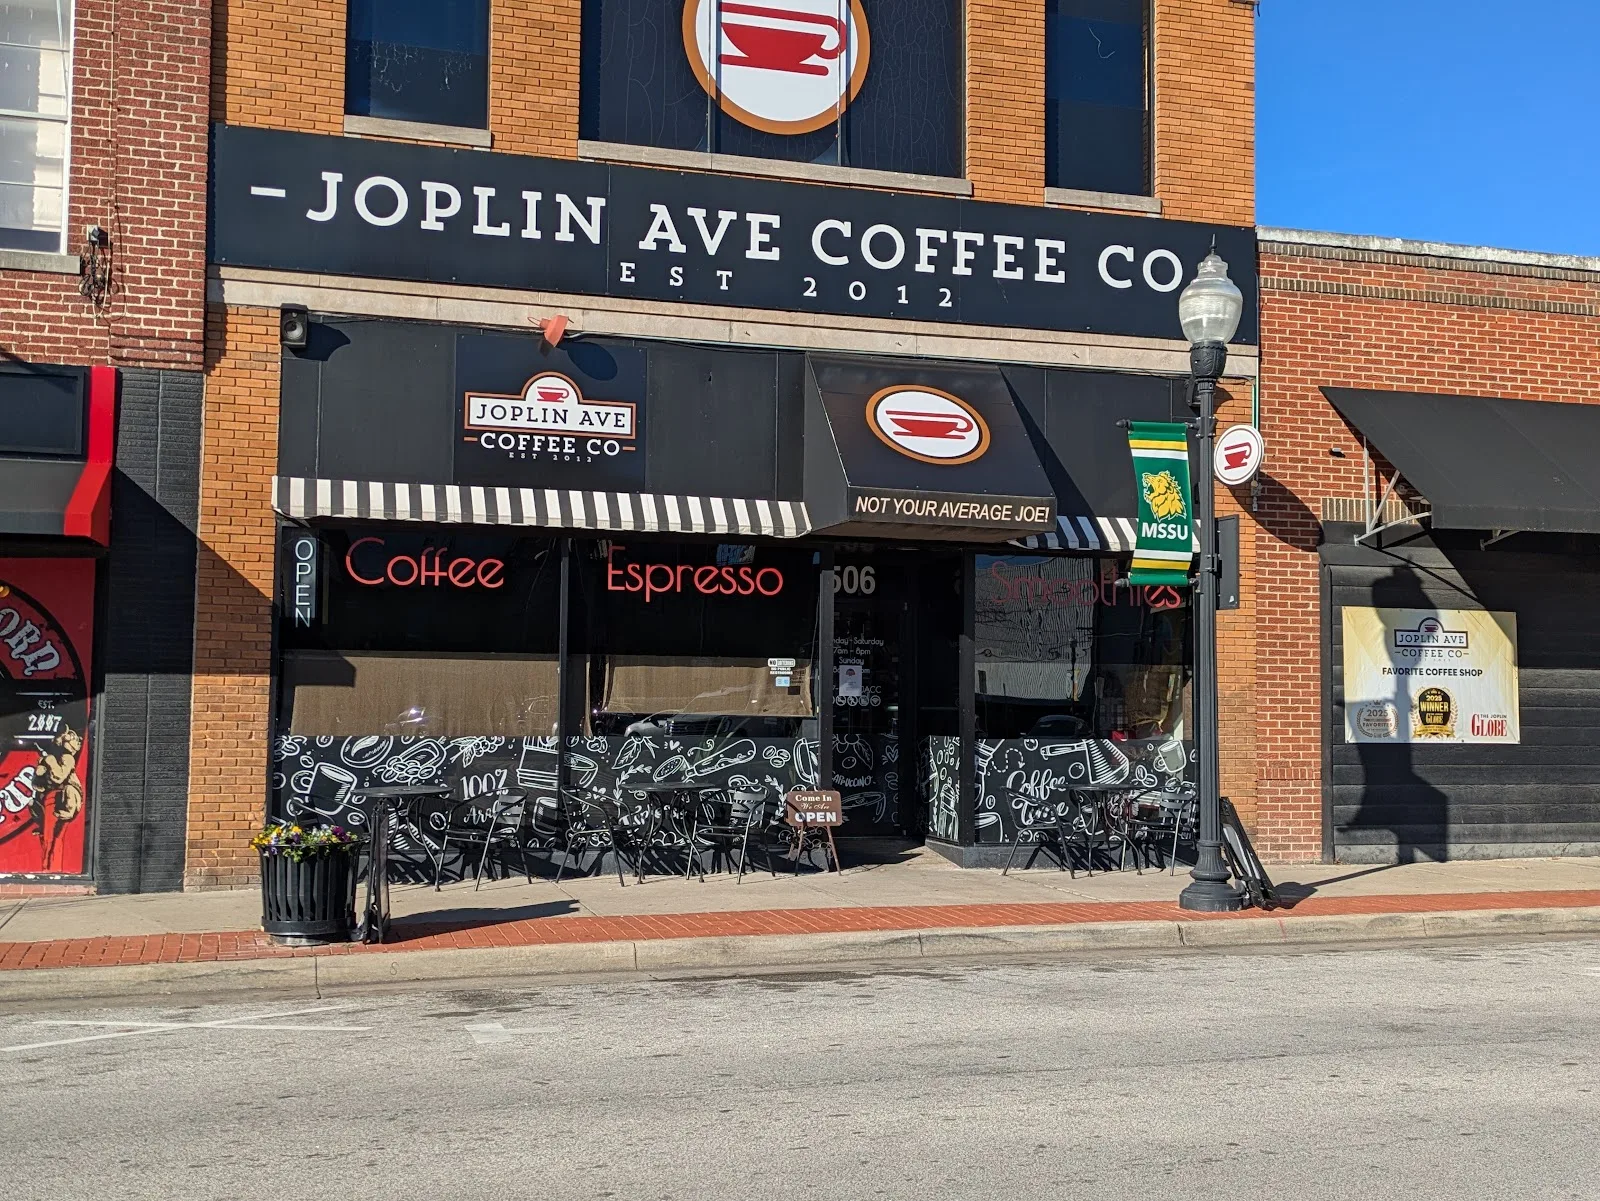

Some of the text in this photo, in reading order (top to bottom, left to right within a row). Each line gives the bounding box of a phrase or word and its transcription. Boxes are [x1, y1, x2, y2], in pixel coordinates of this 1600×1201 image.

[306, 171, 1183, 293] JOPLIN AVE COFFEE CO
[620, 262, 953, 308] EST 2012
[476, 403, 626, 428] JOPLIN AVE
[480, 432, 620, 456] COFFEE CO
[509, 452, 592, 463] EST 2012
[855, 496, 1050, 523] NOT YOUR AVERAGE JOE!
[1141, 522, 1189, 541] MSSU
[345, 536, 505, 589] Coffee
[294, 539, 314, 628] OPEN
[607, 545, 784, 603] Espresso
[1399, 634, 1465, 644] JOPLIN AVE
[839, 656, 865, 666] Sunday
[1401, 648, 1463, 658] COFFEE CO
[1382, 667, 1483, 677] FAVORITE COFFEE SHOP
[1366, 709, 1389, 717] 2025
[1420, 701, 1449, 712] WINNER
[1471, 713, 1507, 737] GLOBE
[794, 811, 837, 823] OPEN
